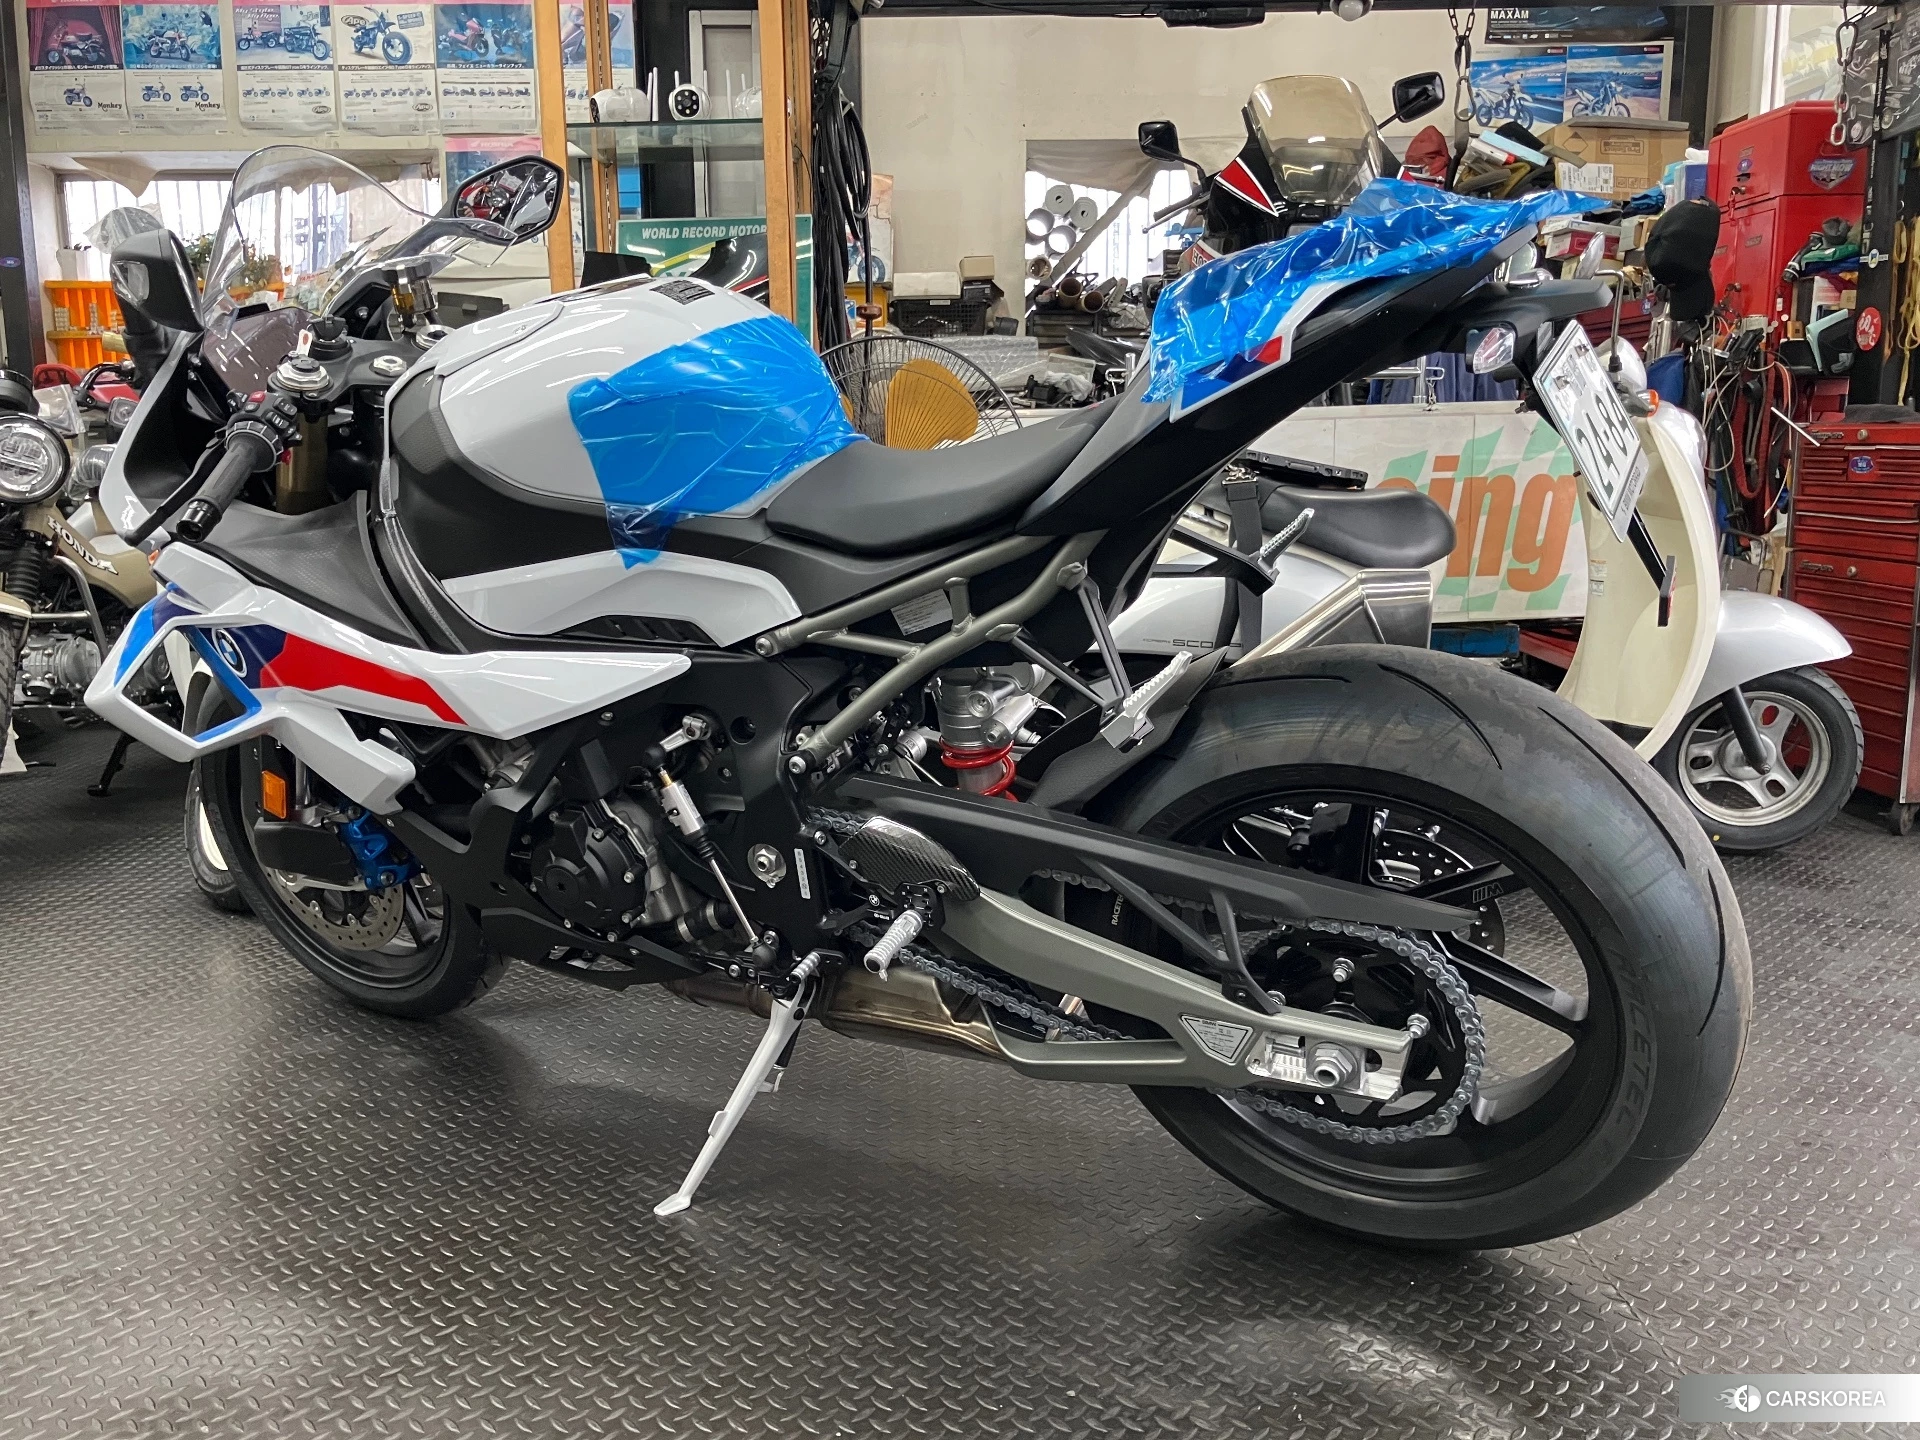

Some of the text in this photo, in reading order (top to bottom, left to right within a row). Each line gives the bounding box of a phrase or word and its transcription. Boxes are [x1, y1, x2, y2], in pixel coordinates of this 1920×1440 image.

[1490, 8, 1529, 19] MAXAM
[97, 102, 122, 112] Monkey
[194, 102, 220, 111] Monkey
[641, 227, 680, 240] WORLD
[682, 226, 726, 238] RECORD
[1376, 455, 1578, 592] ing
[47, 514, 119, 576] HONDA
[1111, 894, 1124, 926] RACETE
